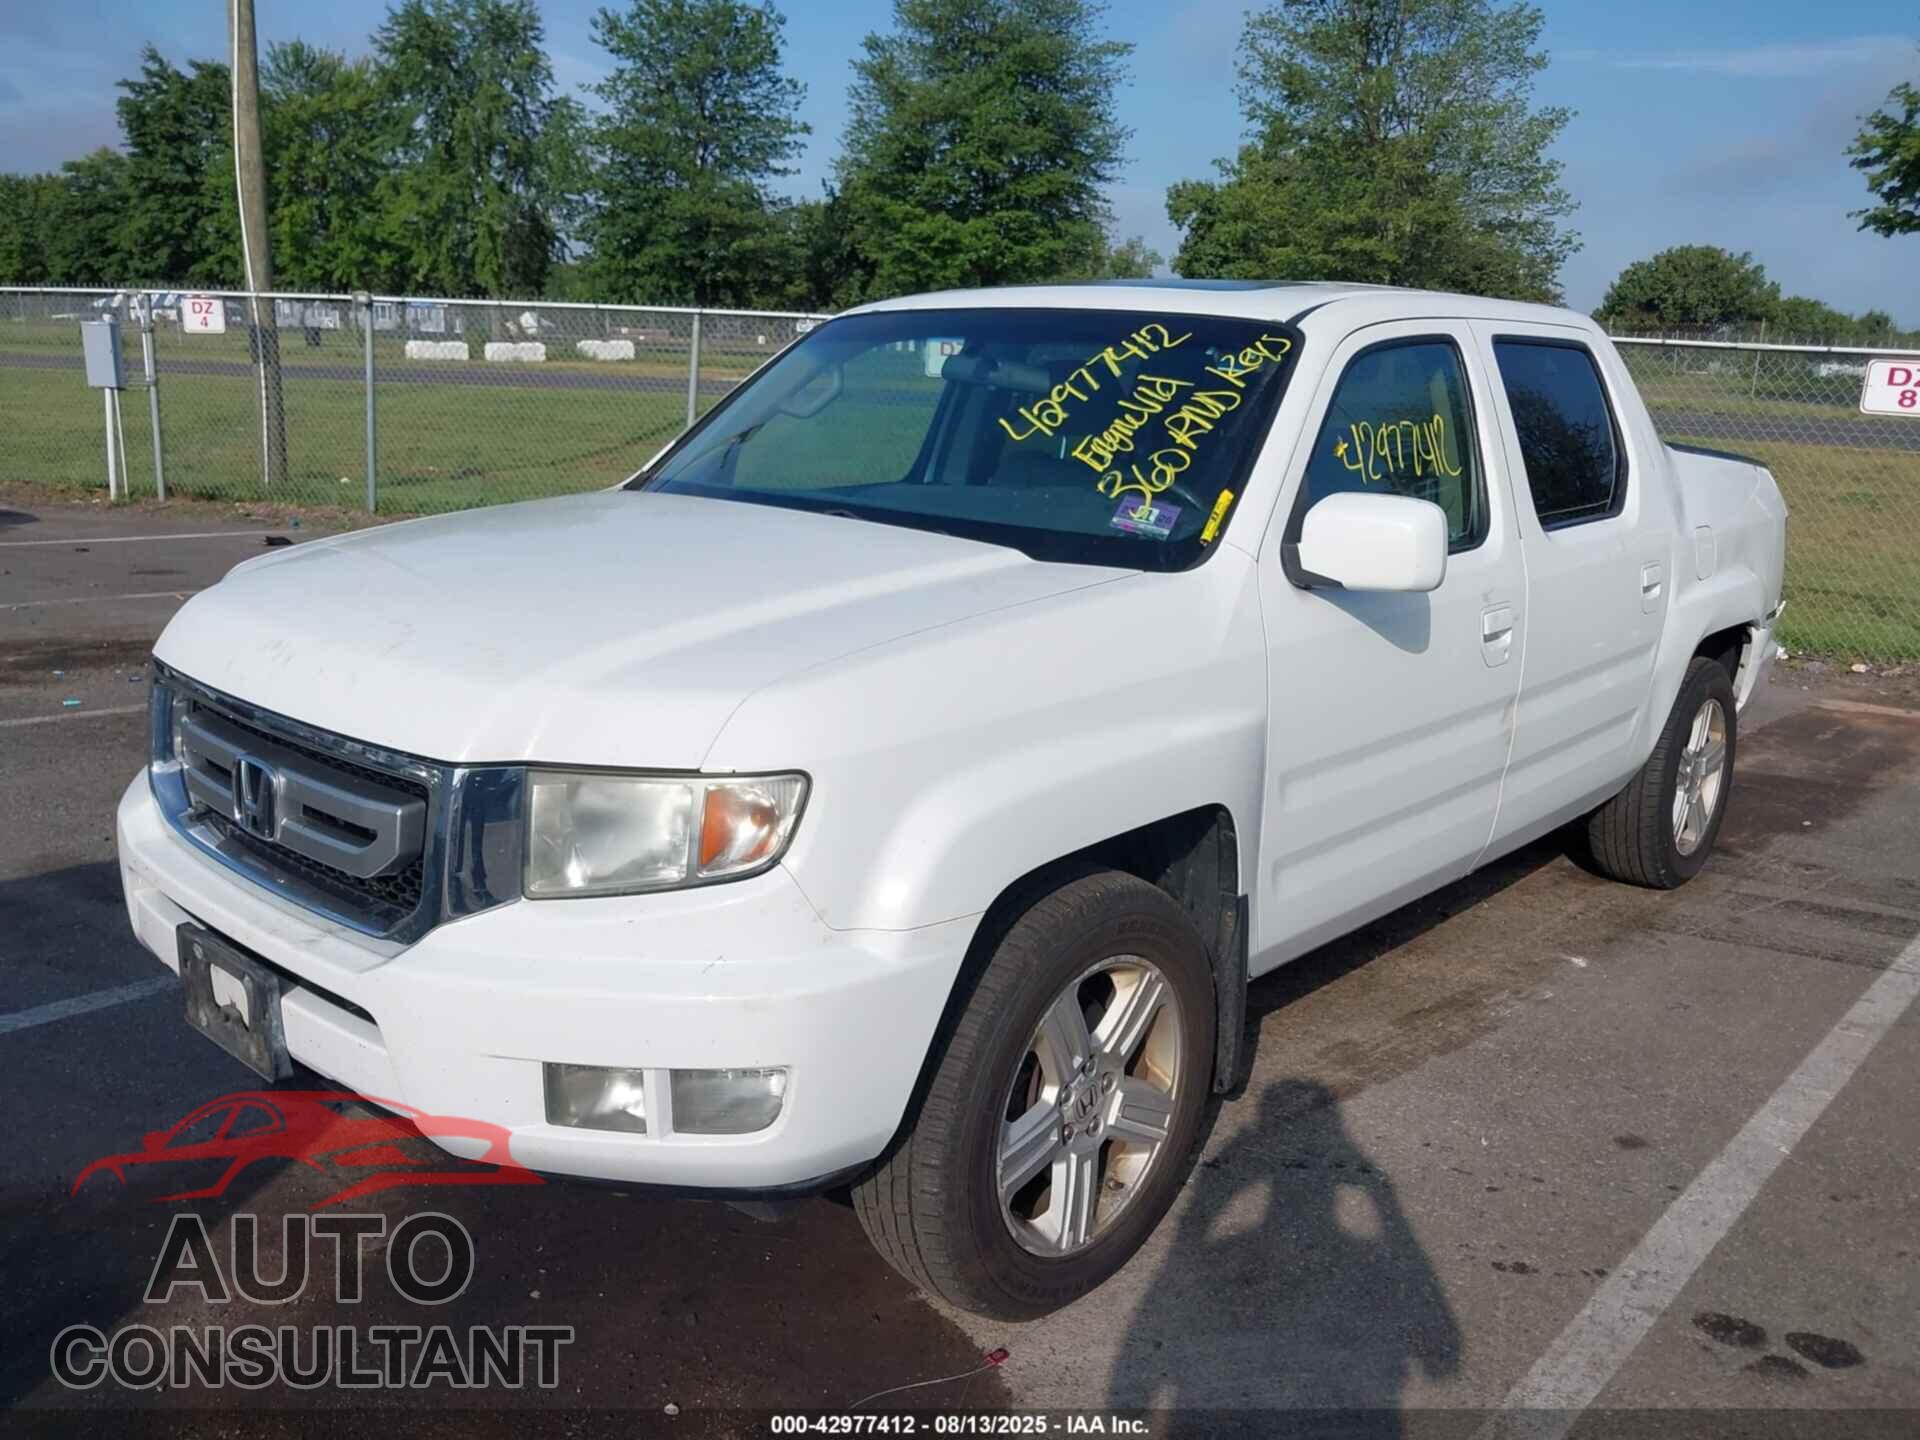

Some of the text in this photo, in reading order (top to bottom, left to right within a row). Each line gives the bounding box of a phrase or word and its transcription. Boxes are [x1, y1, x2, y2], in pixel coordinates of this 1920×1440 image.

[191, 301, 214, 314] DZ
[200, 316, 208, 327] 4
[999, 323, 1192, 440] 42977412
[1897, 389, 1917, 408] 8
[1096, 447, 1190, 519] 360
